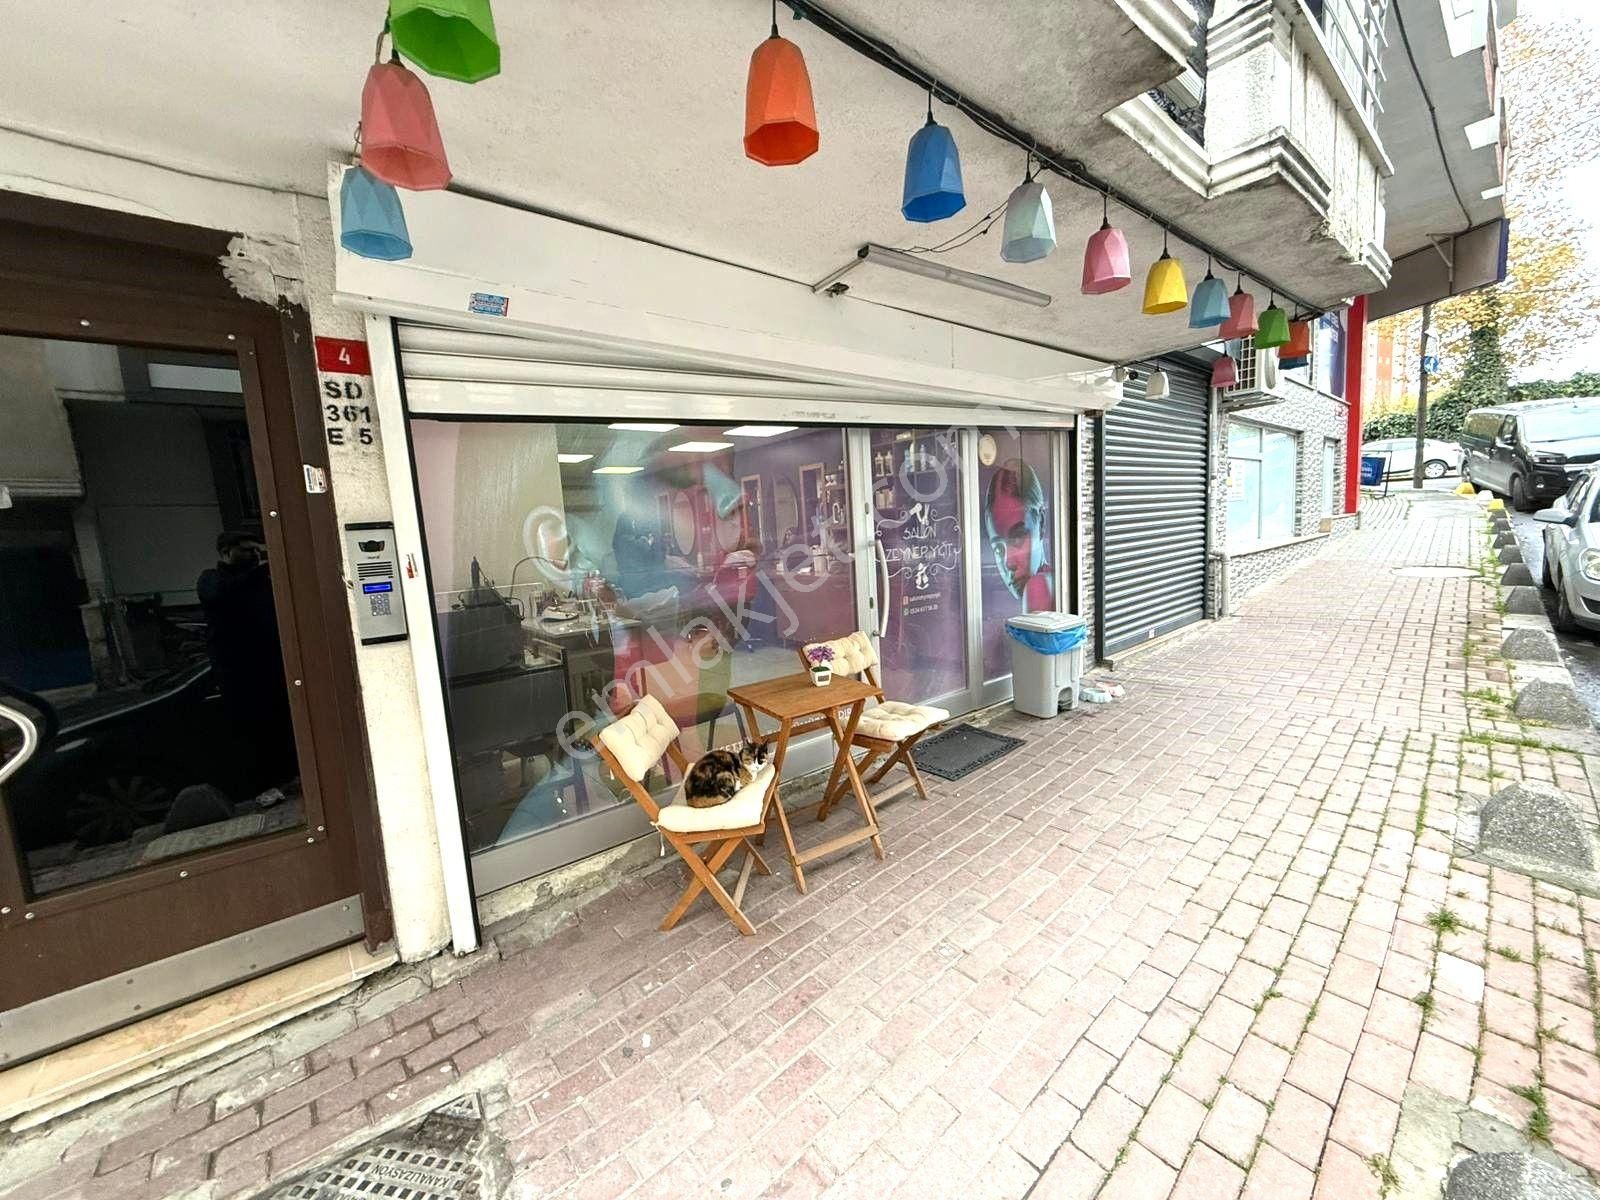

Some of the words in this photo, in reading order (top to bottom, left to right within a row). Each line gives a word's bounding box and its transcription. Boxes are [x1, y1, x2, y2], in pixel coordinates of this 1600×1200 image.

[339, 346, 352, 366] 4
[324, 381, 363, 400] SD
[325, 404, 371, 423] 361
[327, 428, 345, 445] E
[359, 427, 373, 445] 5
[903, 523, 937, 540] SALON
